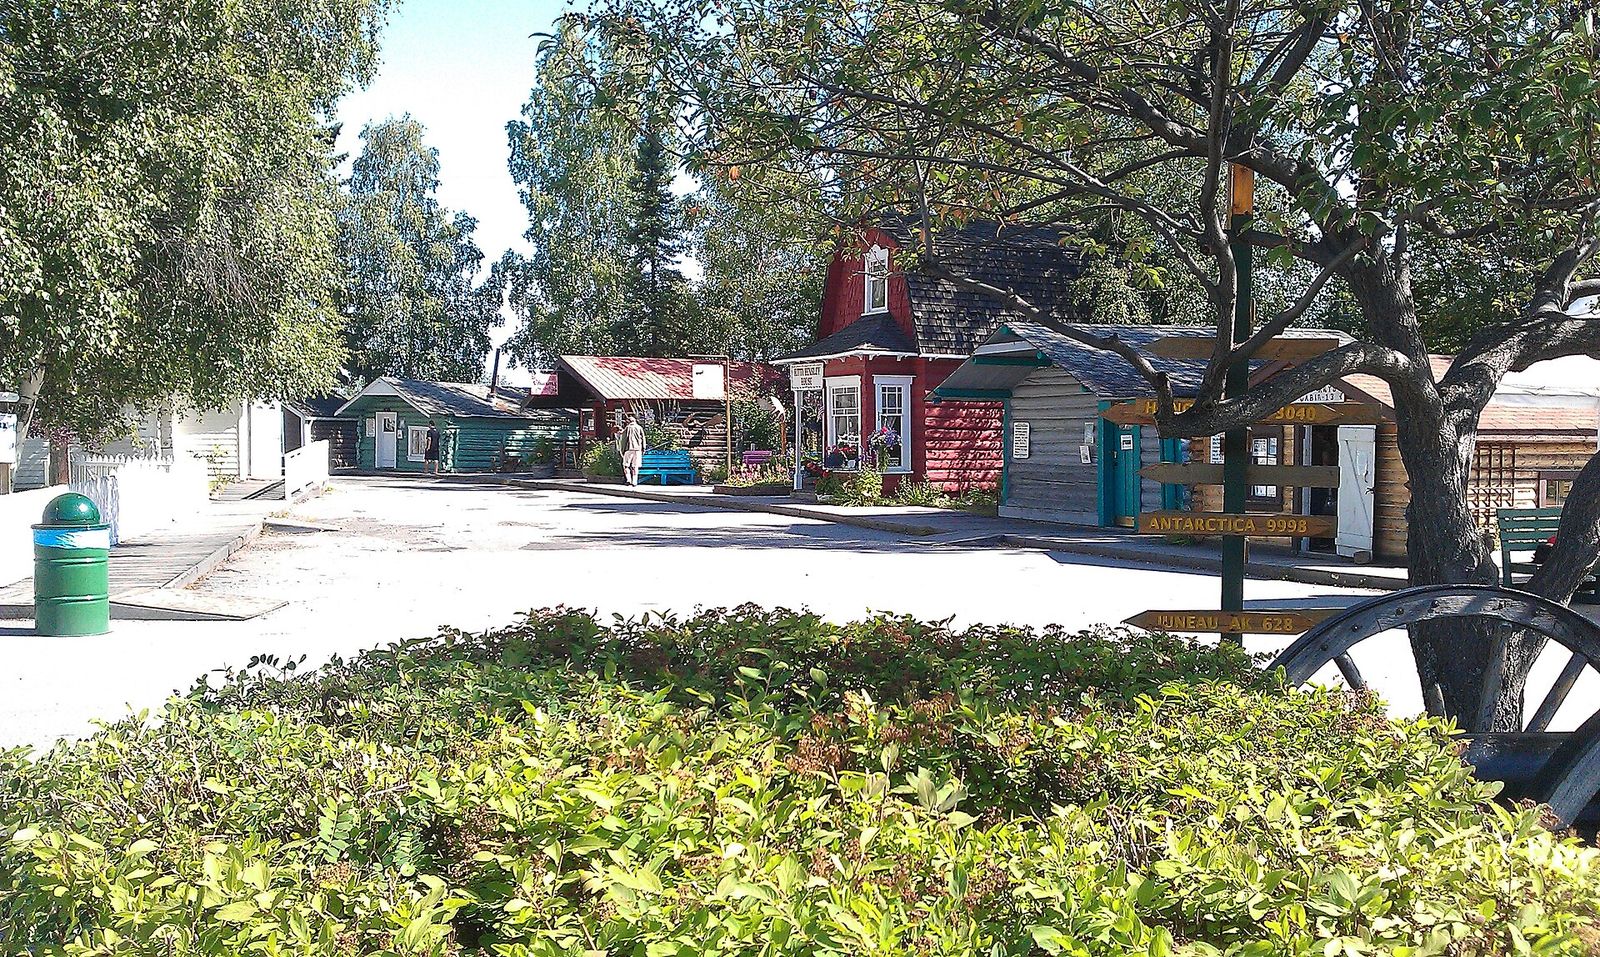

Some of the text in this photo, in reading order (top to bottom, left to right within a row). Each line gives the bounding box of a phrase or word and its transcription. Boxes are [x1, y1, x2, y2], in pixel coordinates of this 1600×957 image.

[1150, 516, 1308, 533] ANTARCTICA 9998
[1157, 615, 1294, 632] JUNEAU AK 628
